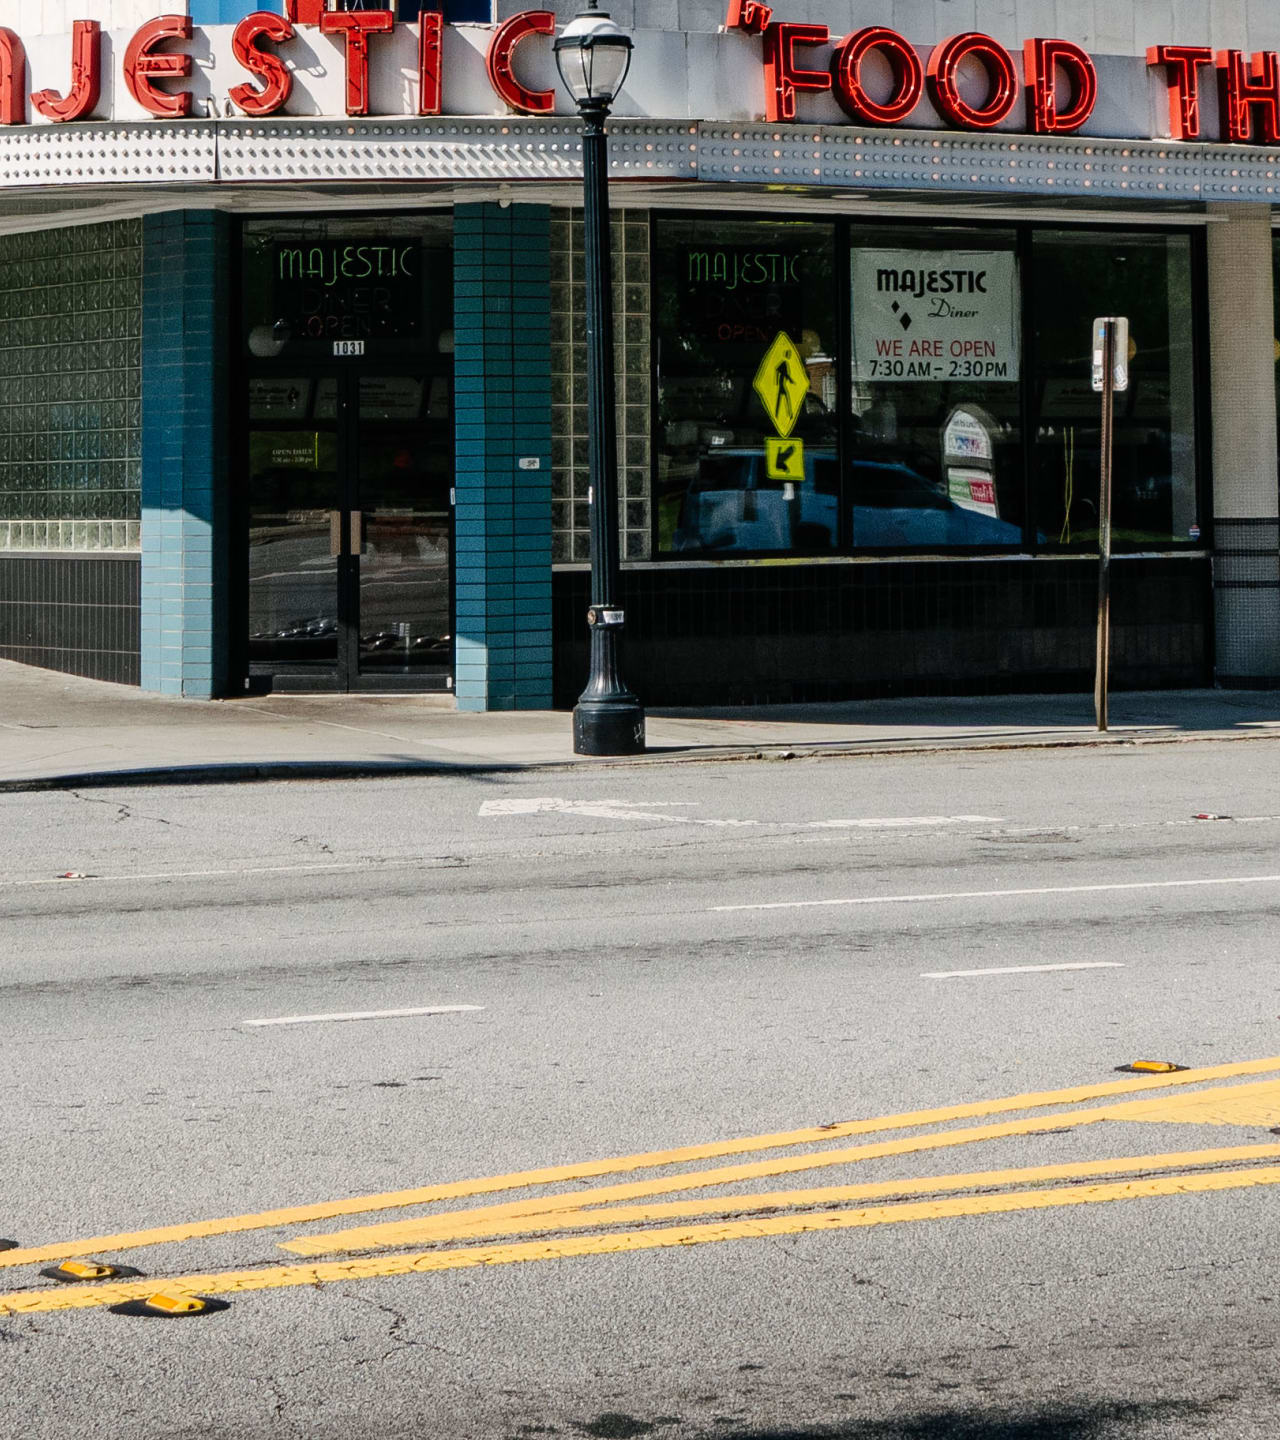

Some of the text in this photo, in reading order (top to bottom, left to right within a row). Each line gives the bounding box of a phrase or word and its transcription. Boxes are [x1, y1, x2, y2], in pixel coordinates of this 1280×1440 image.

[279, 246, 414, 286] MAJESTIC
[688, 252, 800, 289] MAJESTIC
[876, 268, 988, 298] MAJESTIC
[927, 297, 979, 318] Diner
[334, 342, 363, 355] 1031
[876, 339, 996, 357] WE ARE OPEN
[869, 360, 904, 377] 7:30
